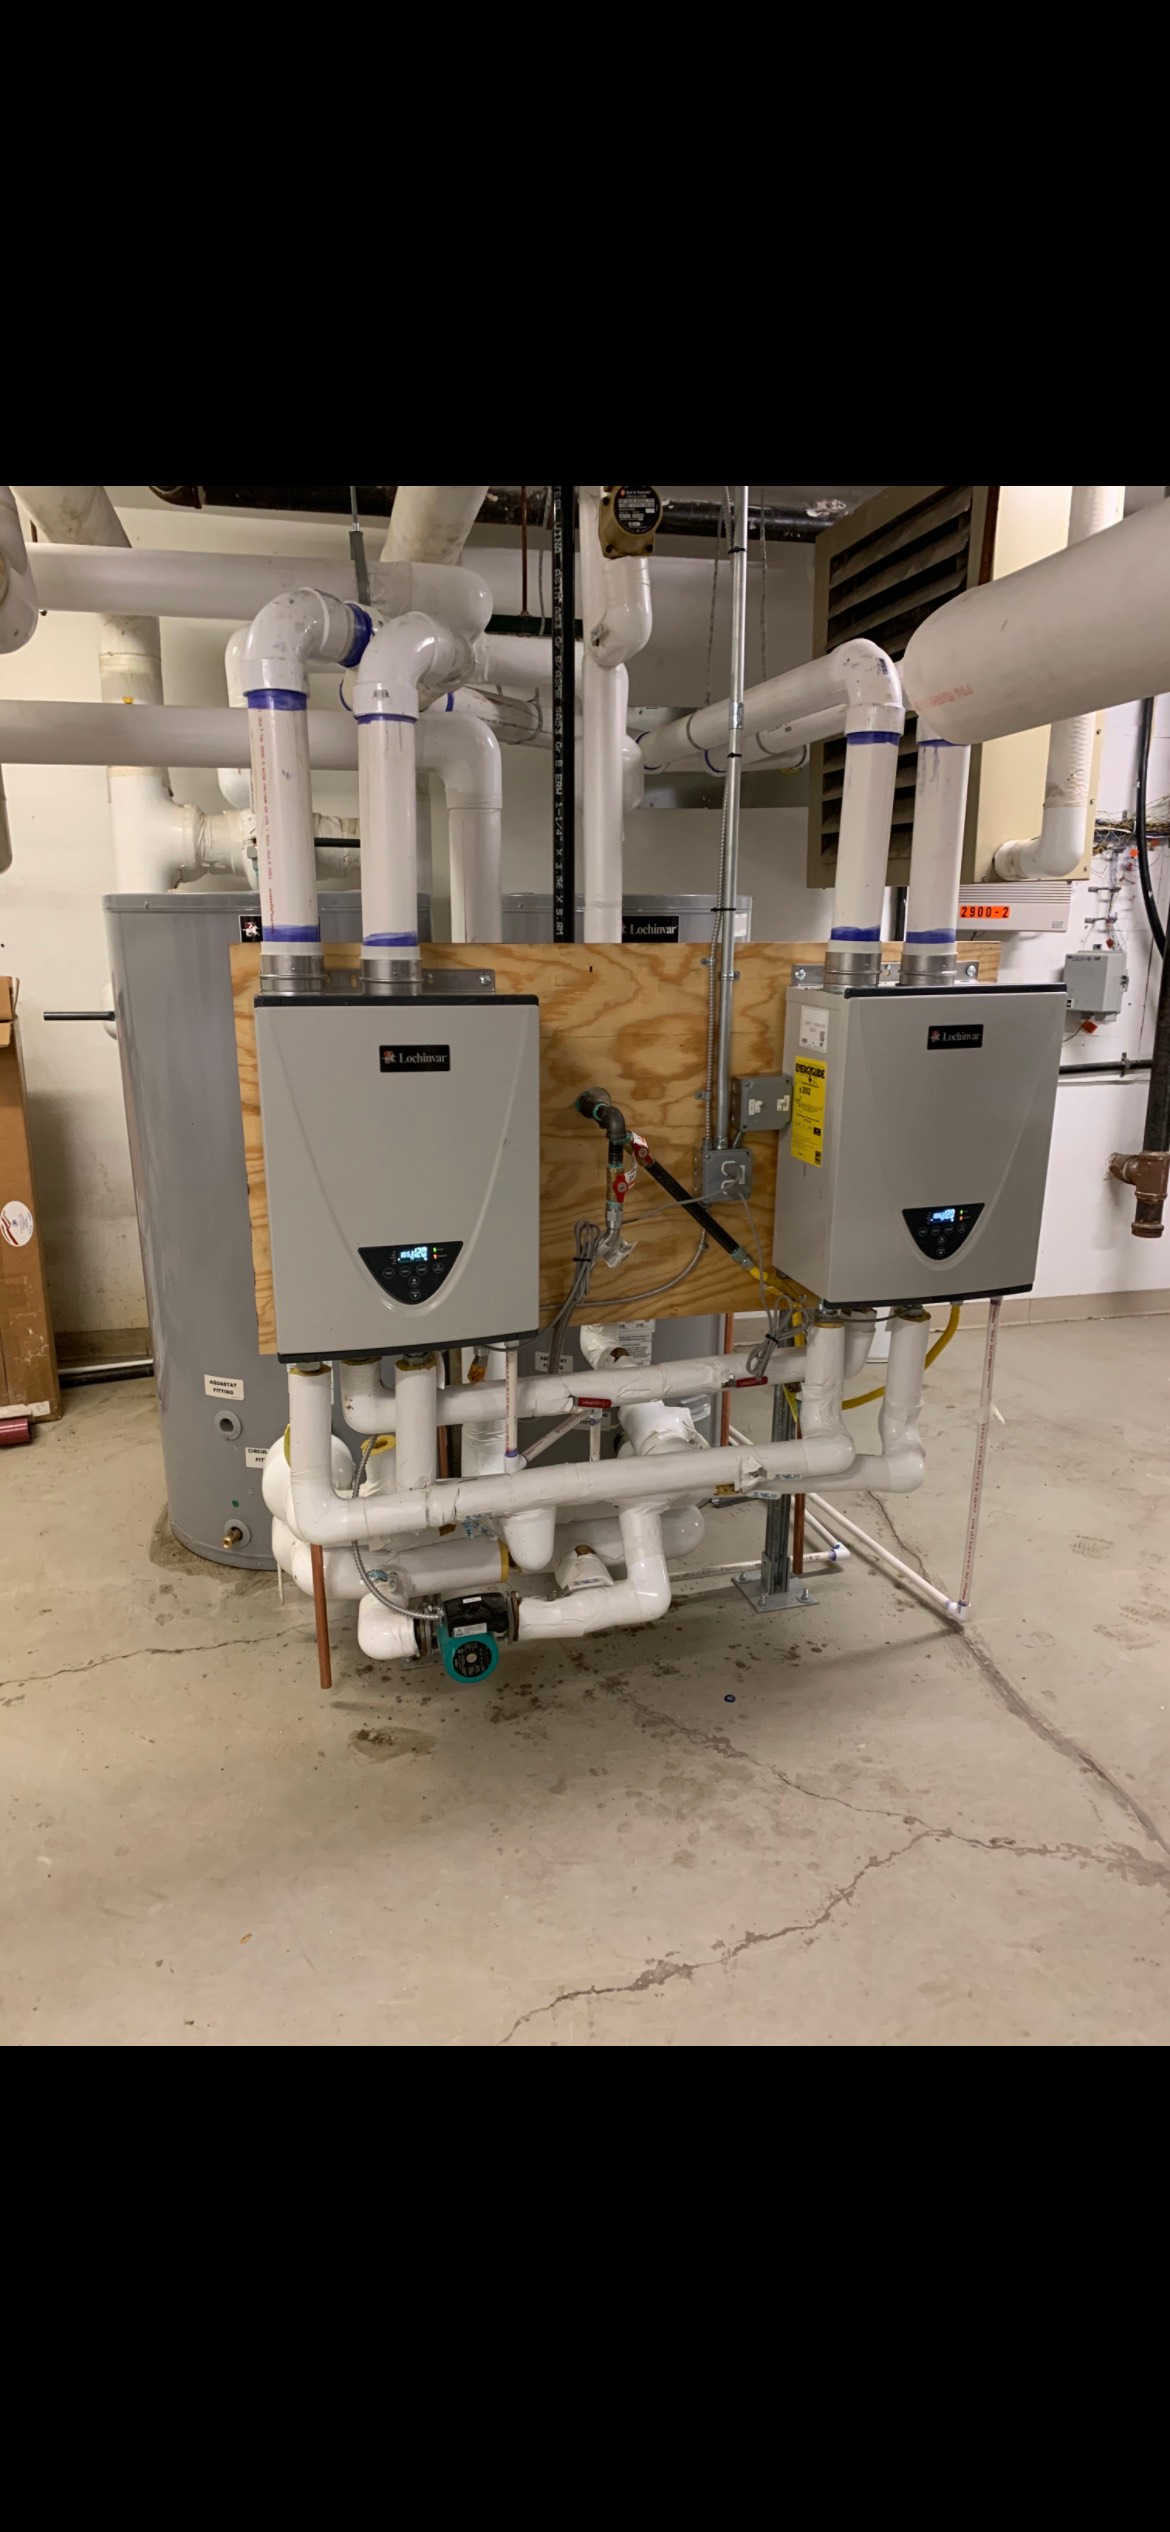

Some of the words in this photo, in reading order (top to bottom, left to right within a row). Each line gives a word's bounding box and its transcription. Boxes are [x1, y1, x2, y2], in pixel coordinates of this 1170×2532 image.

[555, 773, 563, 795] ERW
[960, 905, 1009, 918] 2900-2
[630, 923, 677, 935] Lochinvar
[942, 1031, 981, 1041] Lochinvar
[399, 1052, 447, 1064] Lochinvar
[209, 1380, 238, 1388] AQUASTAT
[213, 1387, 234, 1395] FITTING
